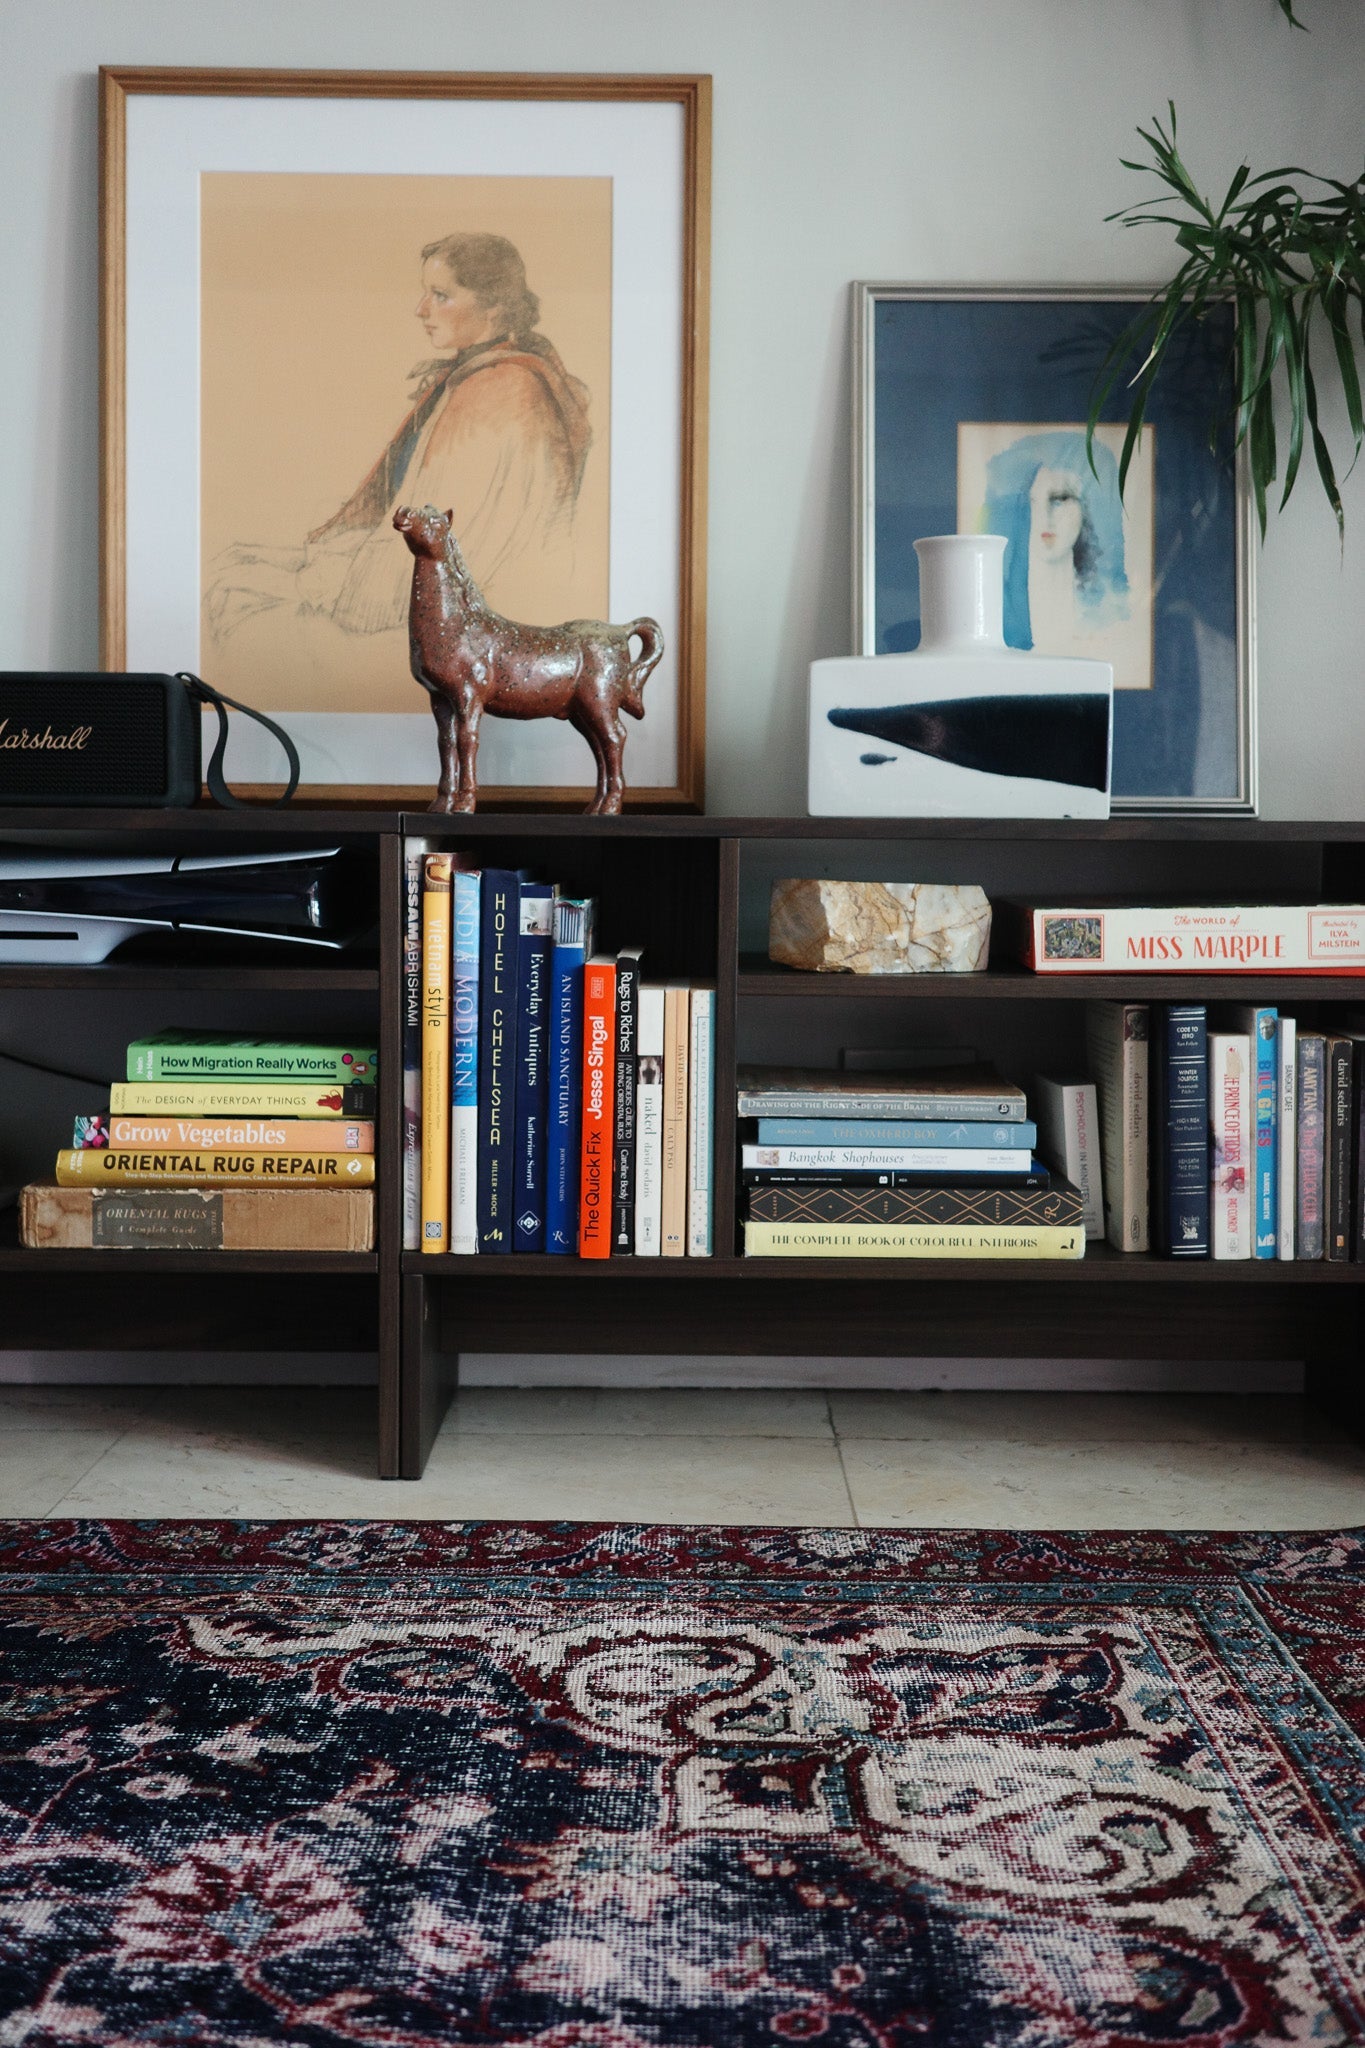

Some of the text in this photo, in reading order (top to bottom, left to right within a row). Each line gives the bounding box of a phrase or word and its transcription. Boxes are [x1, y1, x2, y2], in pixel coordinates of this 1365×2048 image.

[0, 717, 92, 750] arshall
[1173, 914, 1241, 927] The WORLD of
[1329, 929, 1350, 939] ILYA
[1126, 934, 1287, 963] MISS MARPLE
[1318, 939, 1361, 949] MILSTEIN
[454, 889, 474, 1088] INDIA MODERN
[490, 893, 506, 1146] HOTEL CHELSEA
[525, 953, 545, 1086] Everyday Antiques
[618, 972, 635, 1053] Rugs to Riches
[557, 974, 572, 1127] AN ISLAND SANCTUARY
[587, 1016, 608, 1068] Singal
[160, 1056, 337, 1072] How Migration Really Works
[1284, 1064, 1294, 1094] BANGKOK
[1303, 1066, 1318, 1089] AMY
[135, 1095, 152, 1105] The
[155, 1095, 194, 1104] DESIGN
[210, 1096, 263, 1105] EVERYDAY
[267, 1096, 307, 1106] THINGS
[586, 1070, 603, 1120] Jesse
[617, 1062, 625, 1140] BUYING ORIENTAL RUGS
[1133, 1072, 1143, 1139] david sedaris
[1223, 1086, 1241, 1119] PRINCE
[1257, 1060, 1273, 1148] BILL GATES
[1303, 1090, 1318, 1112] TAN
[1337, 1058, 1349, 1127] david sedaris
[114, 1120, 287, 1148] Grow Vegetables
[643, 1097, 658, 1199] naked david sedaris
[666, 1127, 675, 1170] CALYPSO
[832, 1128, 938, 1140] THE OXHERD BOY
[1075, 1091, 1091, 1204] PSYCHOLOGY IN MINUTES
[1224, 1133, 1241, 1163] TIDES
[103, 1153, 207, 1172] ORIENTAL
[213, 1156, 255, 1173] RUG
[262, 1157, 338, 1175] REPAIR
[618, 1149, 630, 1200] Caroline Bosly
[788, 1150, 837, 1167] Bangkok
[841, 1151, 905, 1168] Shophouses
[489, 1159, 499, 1218] MILLER MOCK
[584, 1131, 601, 1242] The Quick Fix
[1302, 1168, 1318, 1194] LUCK
[106, 1208, 208, 1220] ORIENTAL RUGS
[128, 1225, 167, 1235] Complete
[771, 1235, 790, 1245] THE
[793, 1235, 851, 1246] COMPLETE
[857, 1236, 890, 1246] BOOK
[909, 1236, 974, 1248] COLOURFUL
[979, 1237, 1039, 1248] INTERIORS
